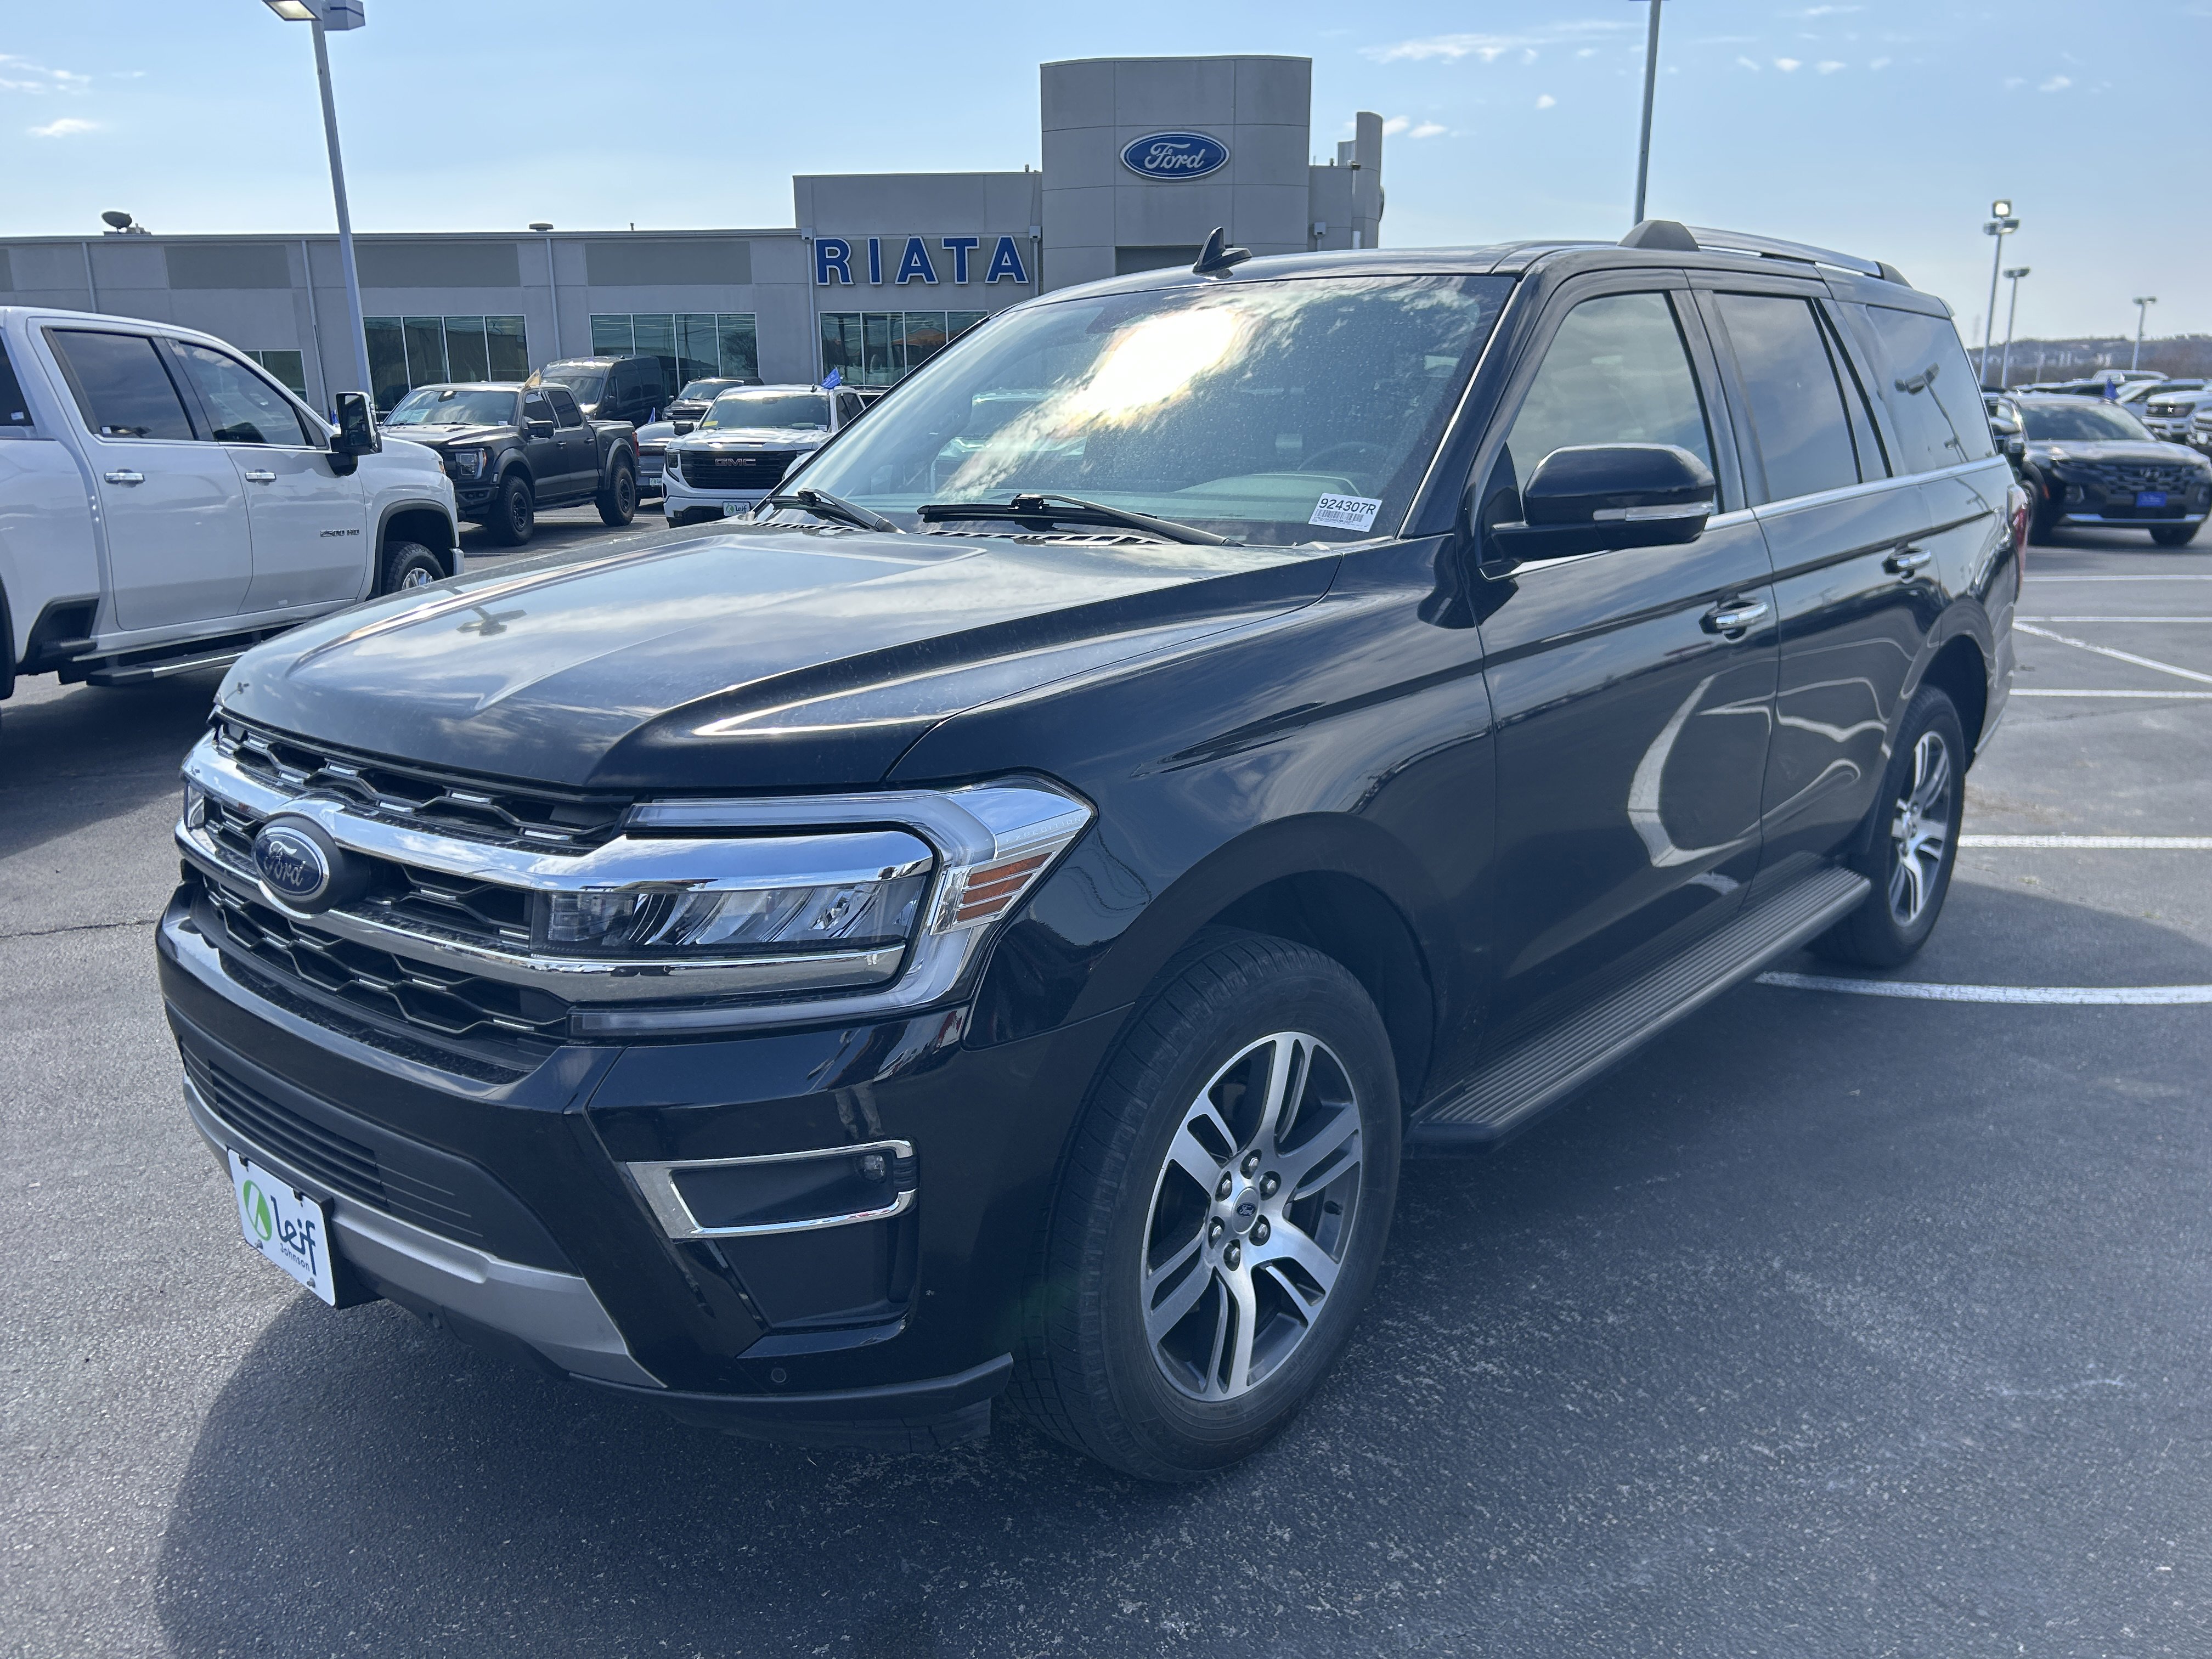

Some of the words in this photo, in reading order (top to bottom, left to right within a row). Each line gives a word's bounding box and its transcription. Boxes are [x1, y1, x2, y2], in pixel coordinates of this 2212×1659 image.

[1144, 142, 1206, 170] Ford
[813, 235, 1030, 285] RIATA
[715, 458, 757, 466] GMC
[1318, 498, 1376, 515] 924307R
[1006, 816, 1081, 843] EXPEDITION
[263, 840, 307, 887] Ford
[1239, 1204, 1255, 1216] Ford
[280, 1242, 311, 1272] Johnson
